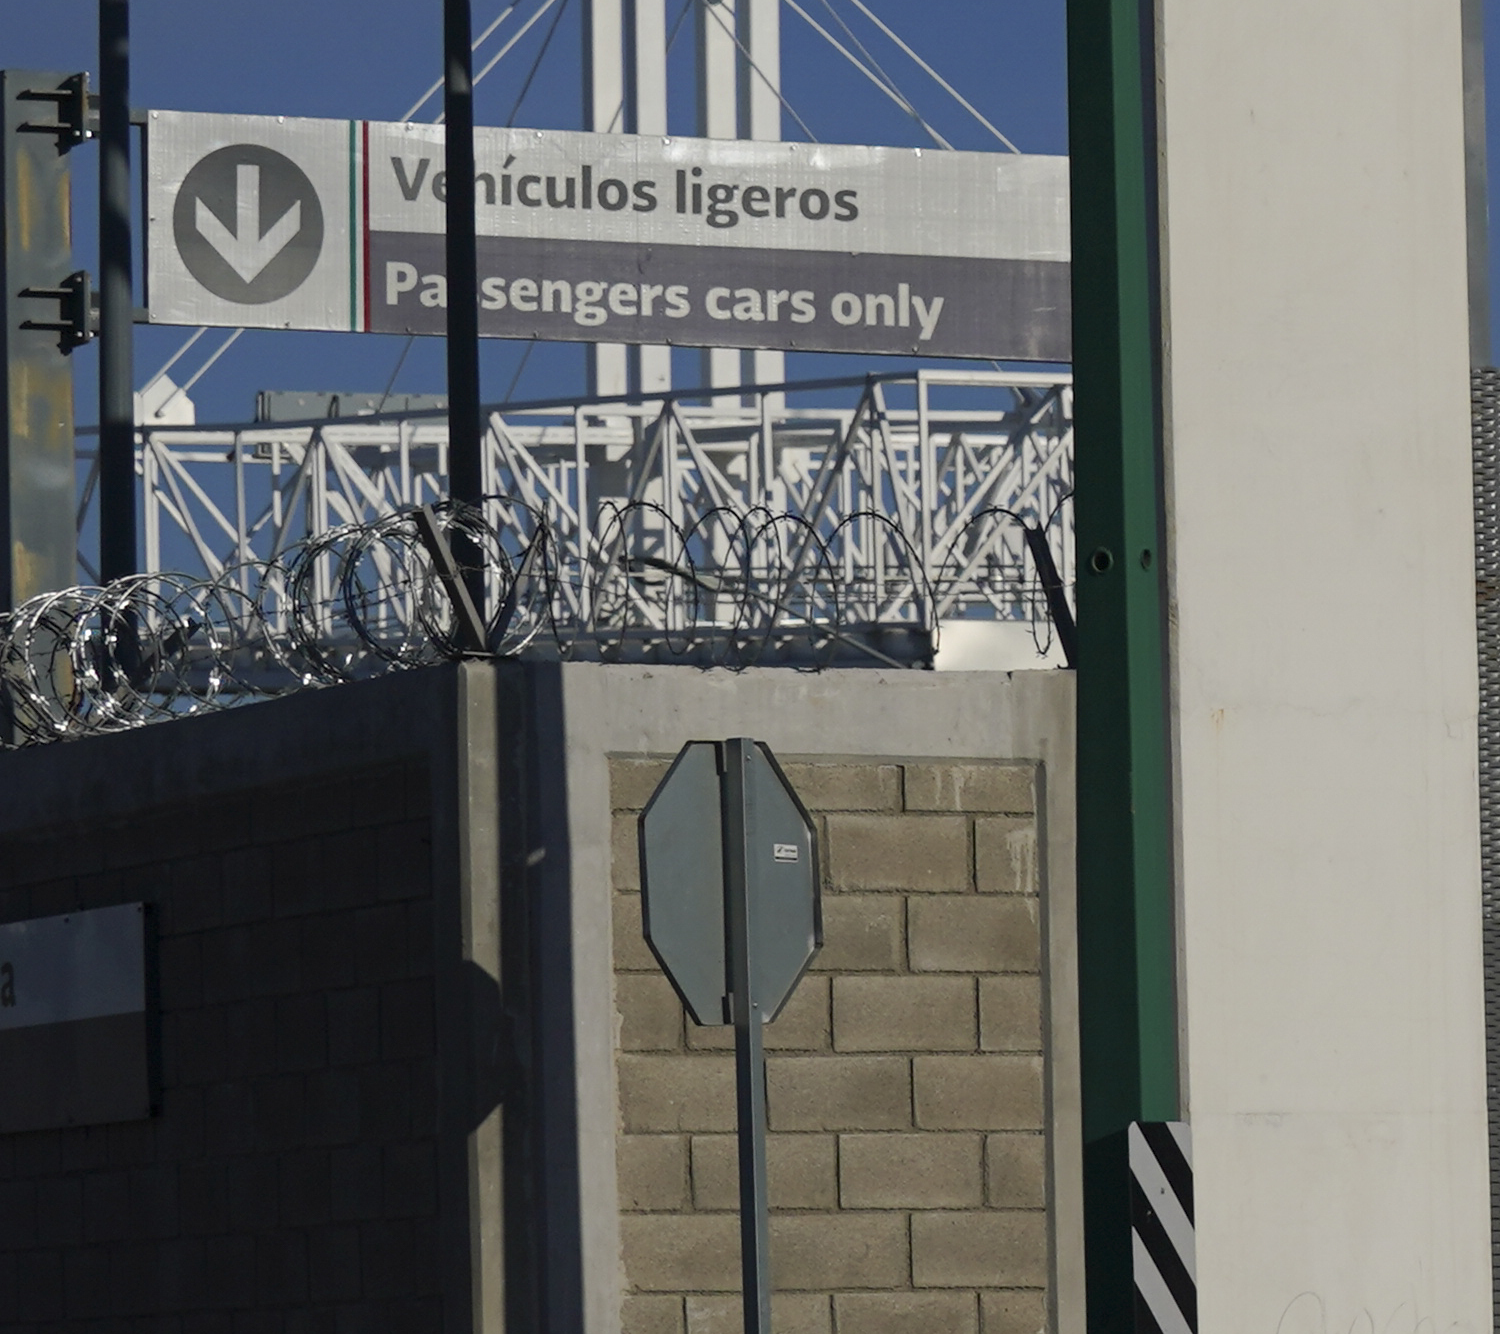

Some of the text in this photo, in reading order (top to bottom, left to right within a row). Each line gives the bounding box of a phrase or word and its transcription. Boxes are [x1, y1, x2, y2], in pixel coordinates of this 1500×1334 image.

[675, 167, 859, 229] ligeros
[386, 261, 945, 341] Pasengers cars only
